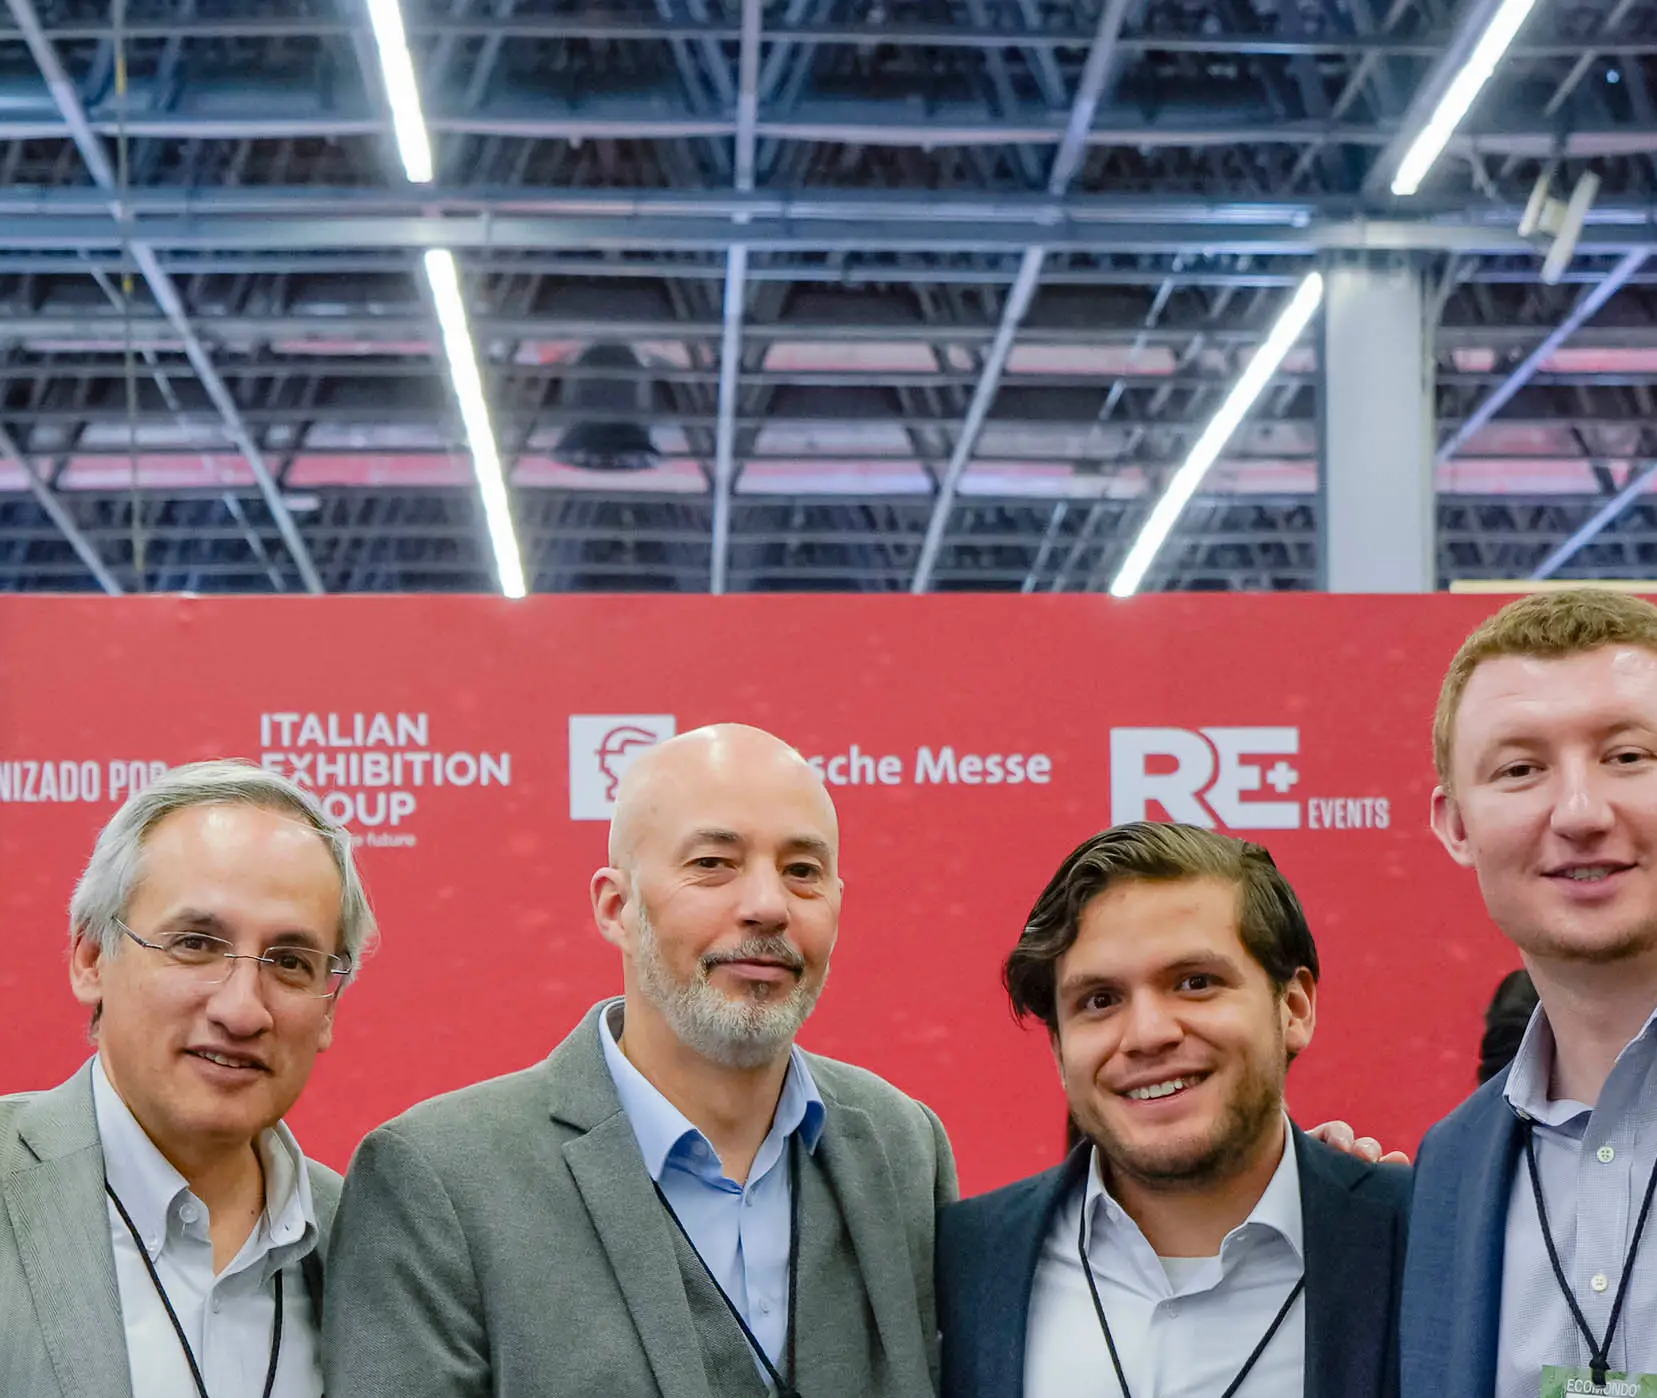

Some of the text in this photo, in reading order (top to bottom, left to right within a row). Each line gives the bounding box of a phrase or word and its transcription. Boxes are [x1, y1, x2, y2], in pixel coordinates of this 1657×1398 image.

[260, 713, 428, 747] ITALIAN
[260, 752, 511, 787] EXHIBITION
[807, 744, 1052, 785] sche Messe
[320, 791, 416, 826] OUP
[1308, 797, 1390, 829] EVENTS
